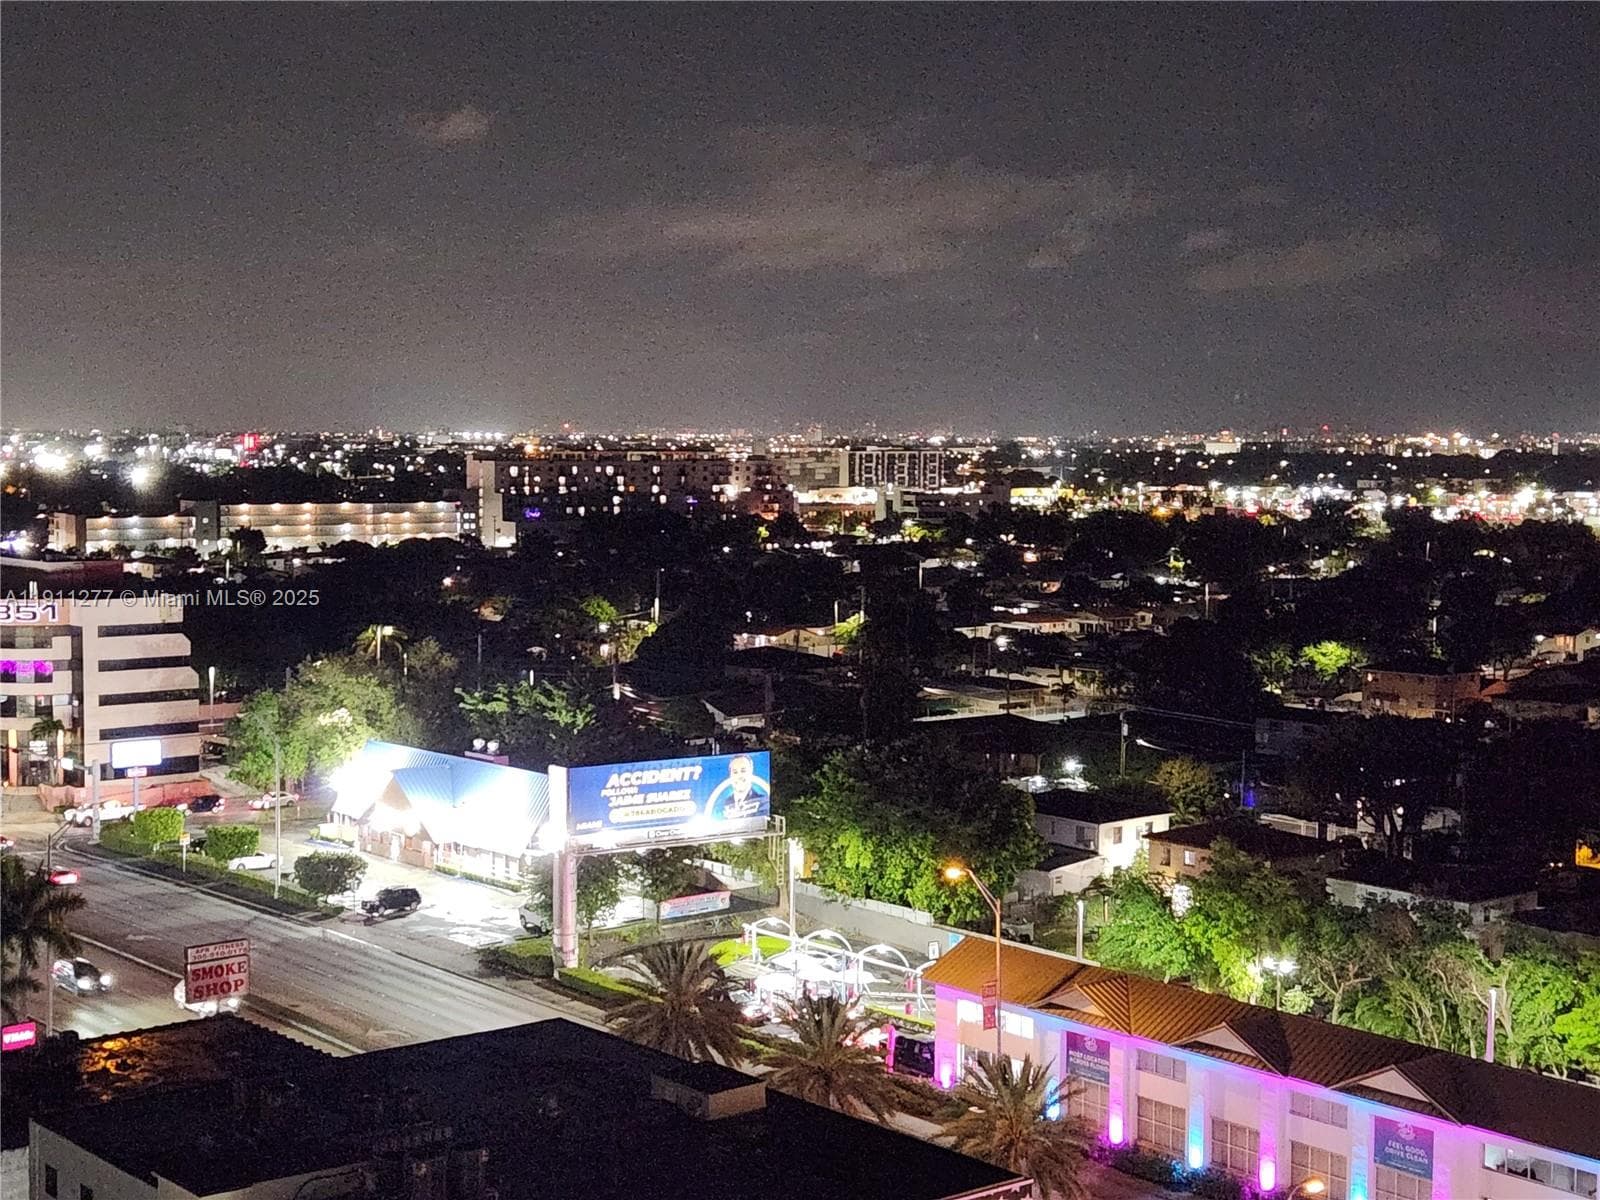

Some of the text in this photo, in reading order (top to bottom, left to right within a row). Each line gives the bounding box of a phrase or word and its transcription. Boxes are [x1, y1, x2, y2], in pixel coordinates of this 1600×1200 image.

[605, 765, 703, 789] ACCIDENT?
[191, 961, 247, 982] SMOKE
[193, 978, 244, 999] SHOP
[1388, 1140, 1403, 1152] FEEL
[1406, 1152, 1429, 1165] CLEAN
